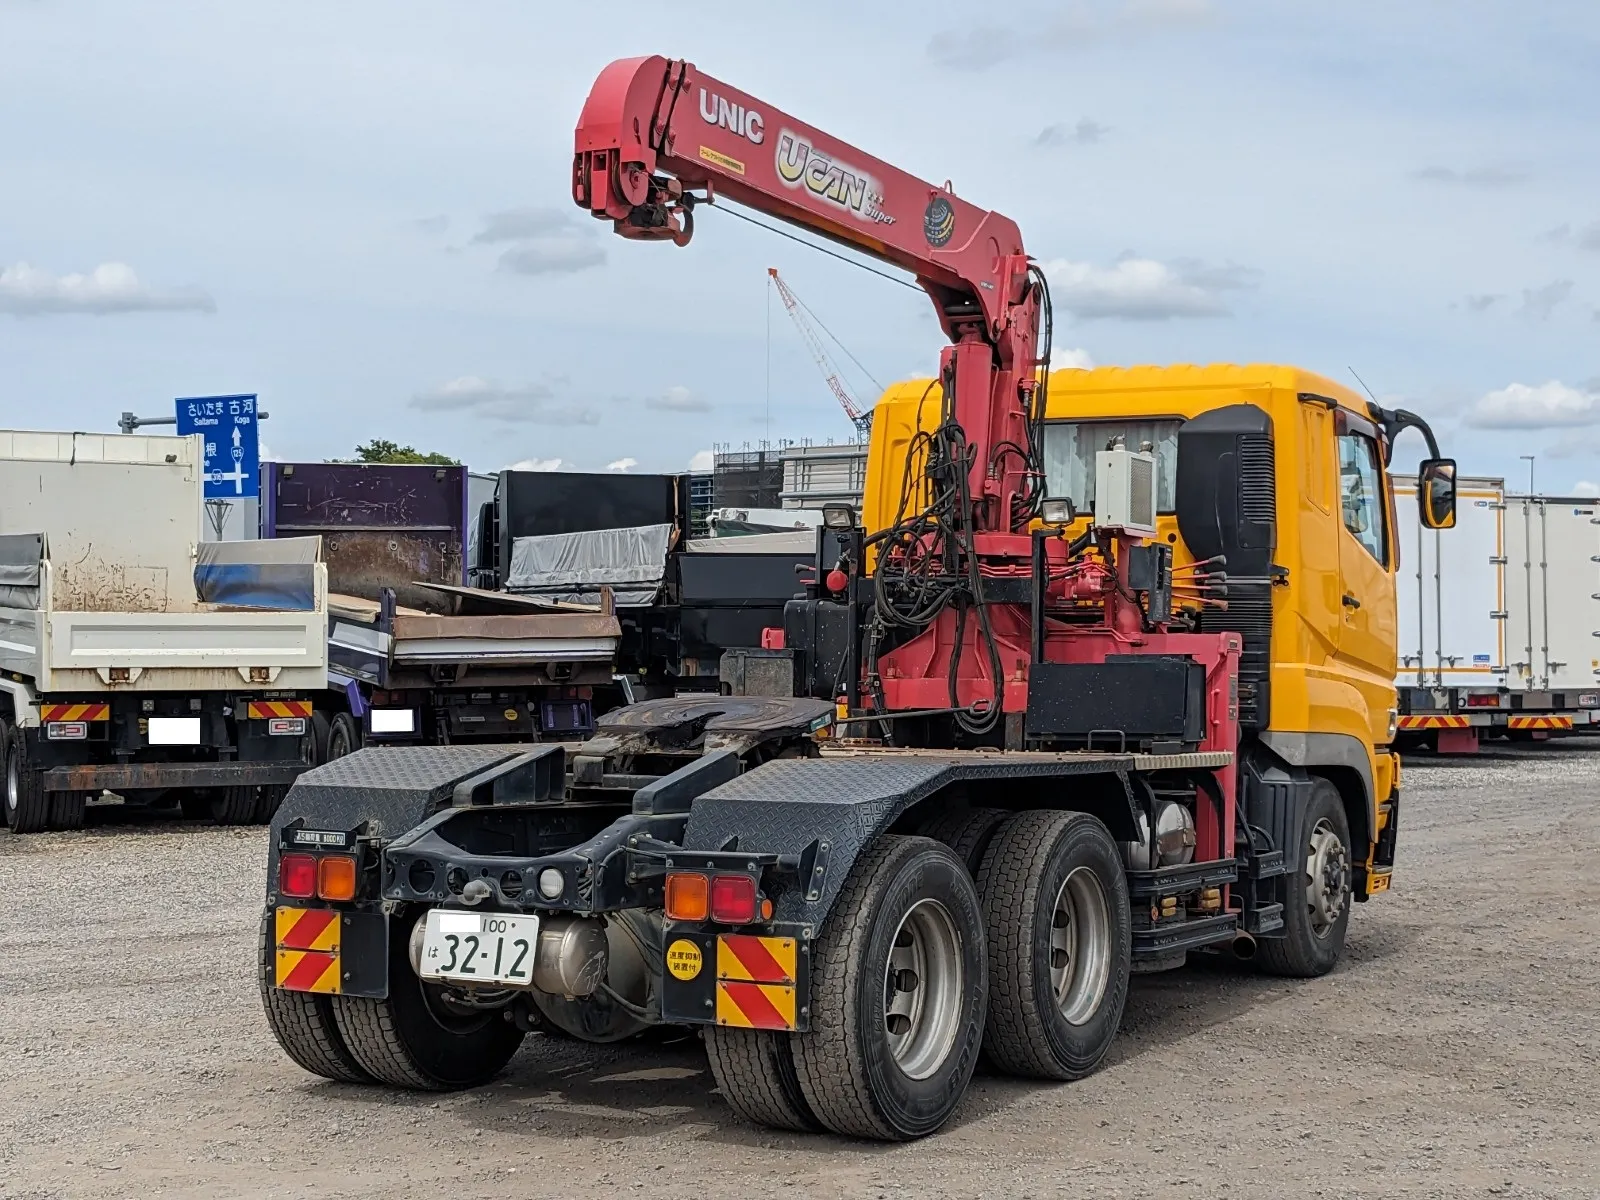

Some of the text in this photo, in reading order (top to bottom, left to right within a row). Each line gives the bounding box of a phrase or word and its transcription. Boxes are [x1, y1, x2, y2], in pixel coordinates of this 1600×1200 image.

[699, 87, 764, 145] UNIC
[864, 203, 896, 226] Super
[187, 402, 224, 417] さいたま
[228, 399, 254, 415] 古河
[194, 418, 219, 426] Saitama
[234, 416, 250, 425] Koga
[203, 442, 217, 457] 根
[232, 449, 242, 458] 125
[482, 919, 507, 933] 100
[427, 934, 529, 978] は 32-12
